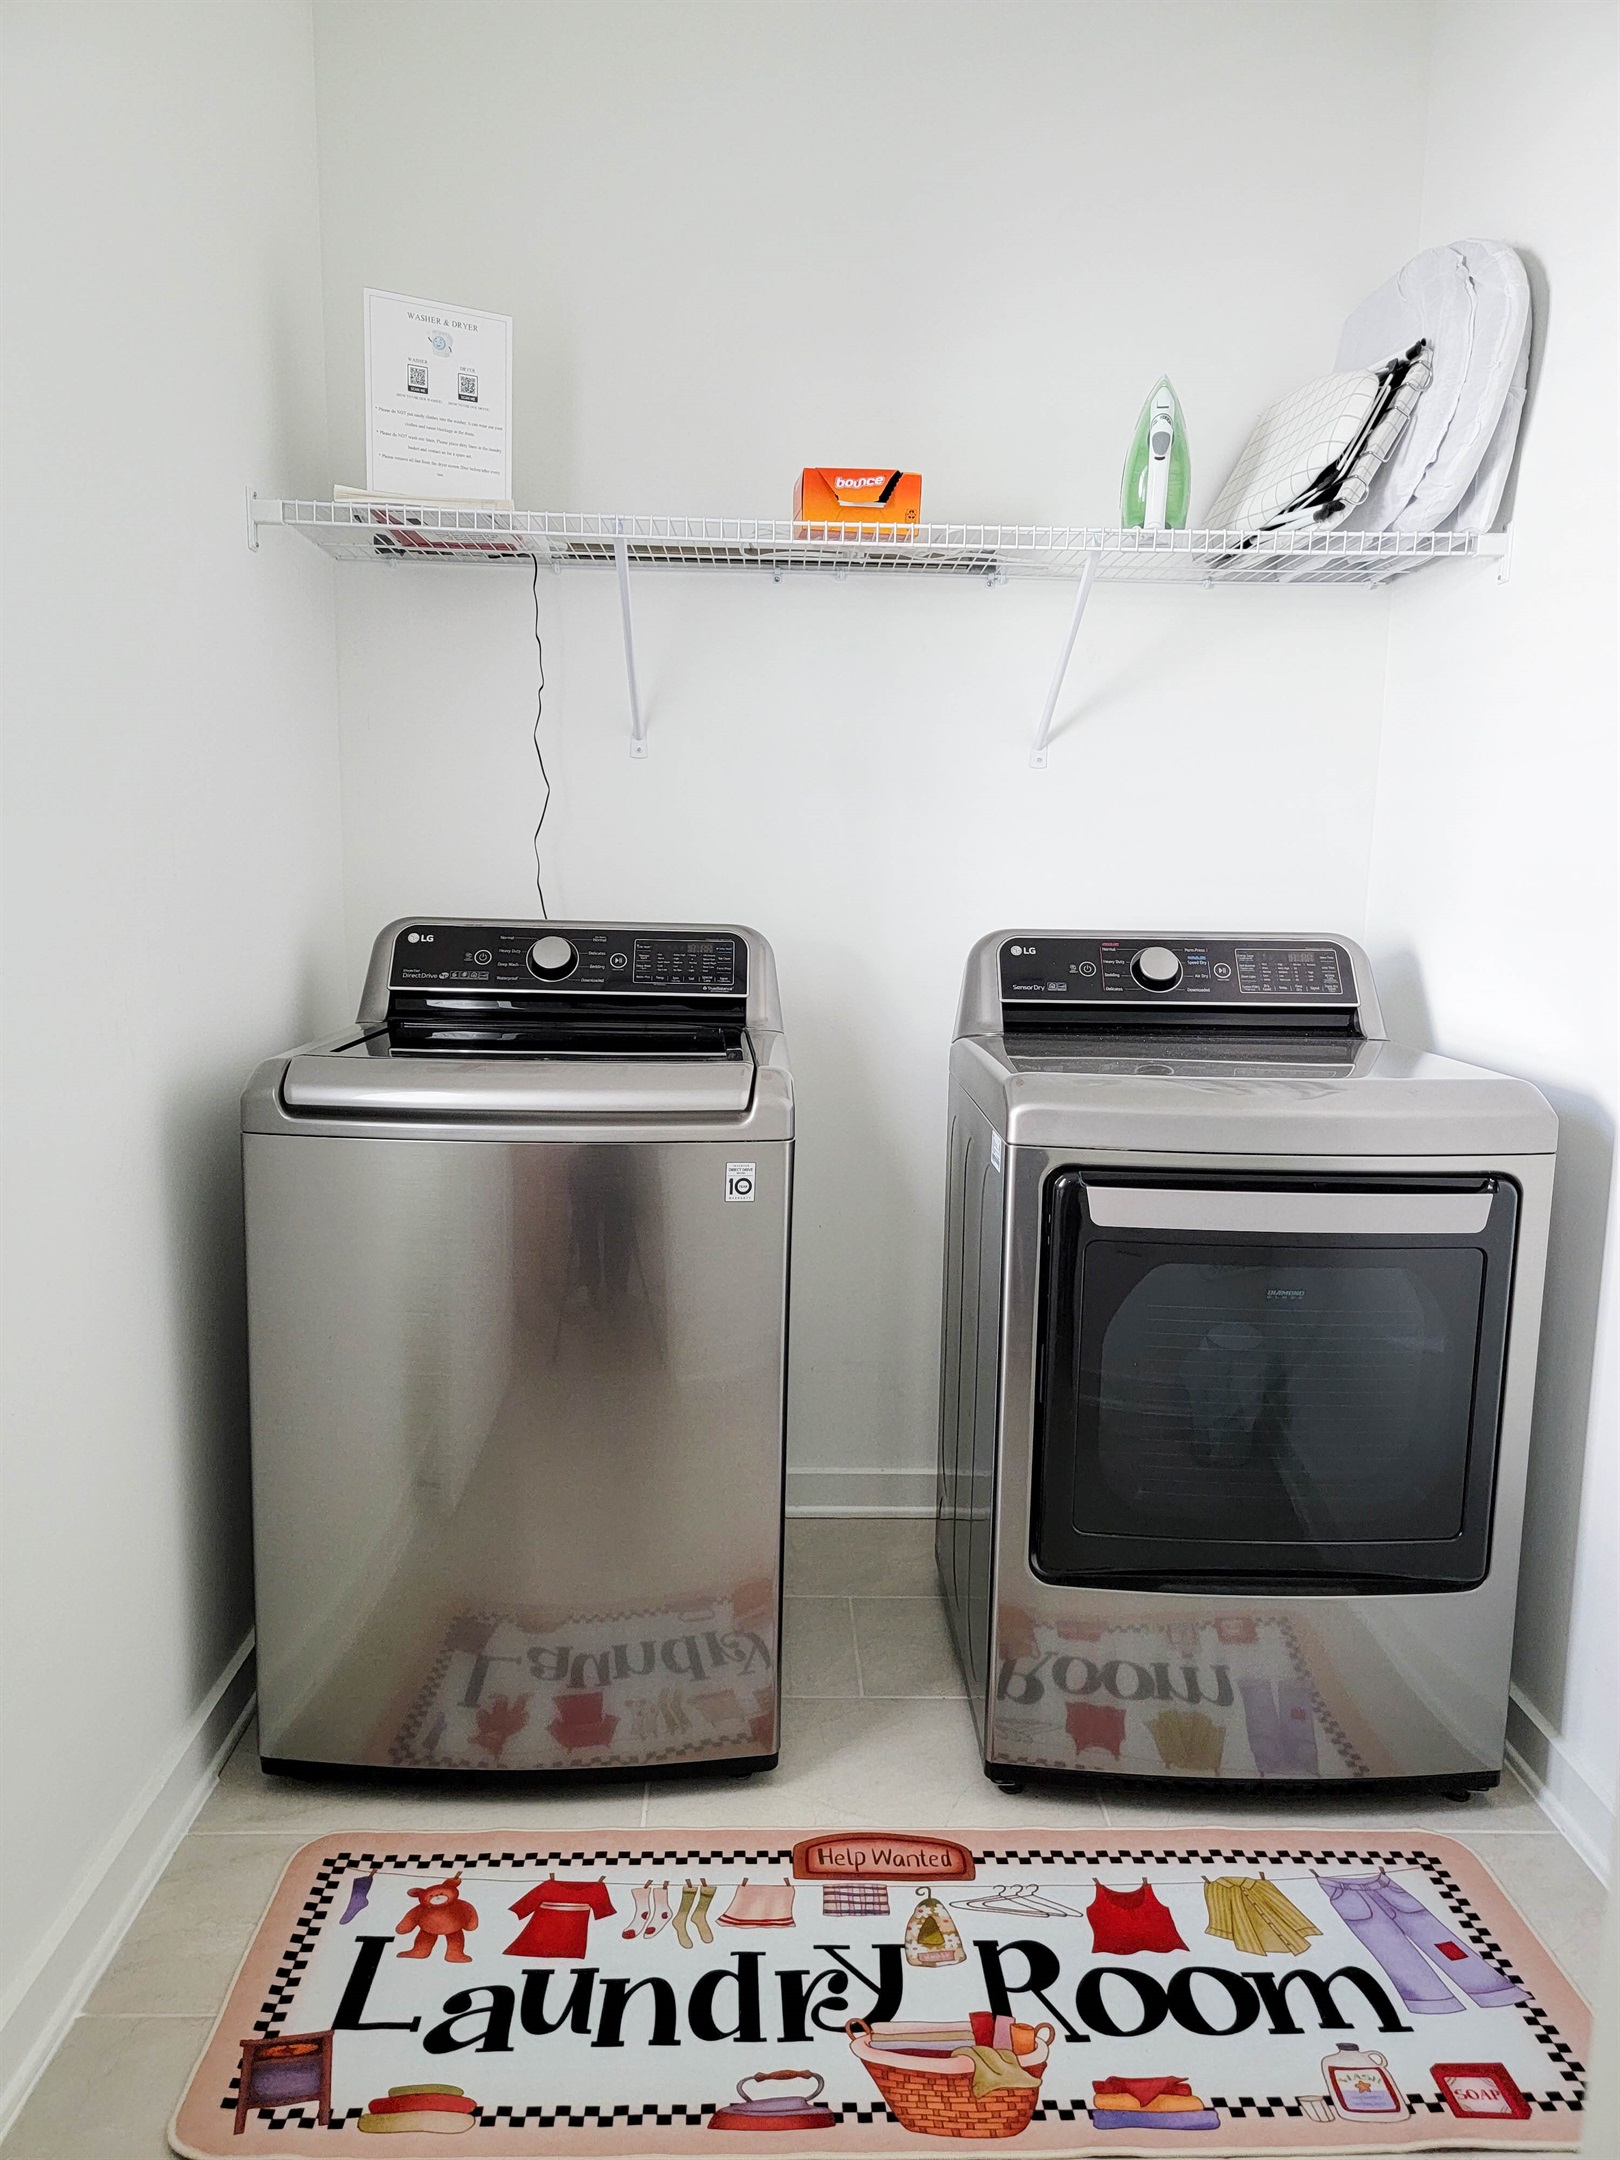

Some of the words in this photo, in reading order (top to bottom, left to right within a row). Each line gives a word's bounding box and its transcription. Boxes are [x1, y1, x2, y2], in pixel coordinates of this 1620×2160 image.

[407, 312, 442, 324] WASHER
[452, 322, 478, 332] DRYER
[408, 356, 428, 364] WASHER
[836, 476, 884, 488] bounce
[729, 1178, 752, 1195] 10
[818, 1848, 866, 1872] Help
[872, 1848, 952, 1868] Wanted
[332, 1935, 905, 2054] Laundry
[972, 1939, 1413, 2042] Room
[1454, 2088, 1502, 2100] SOAP
